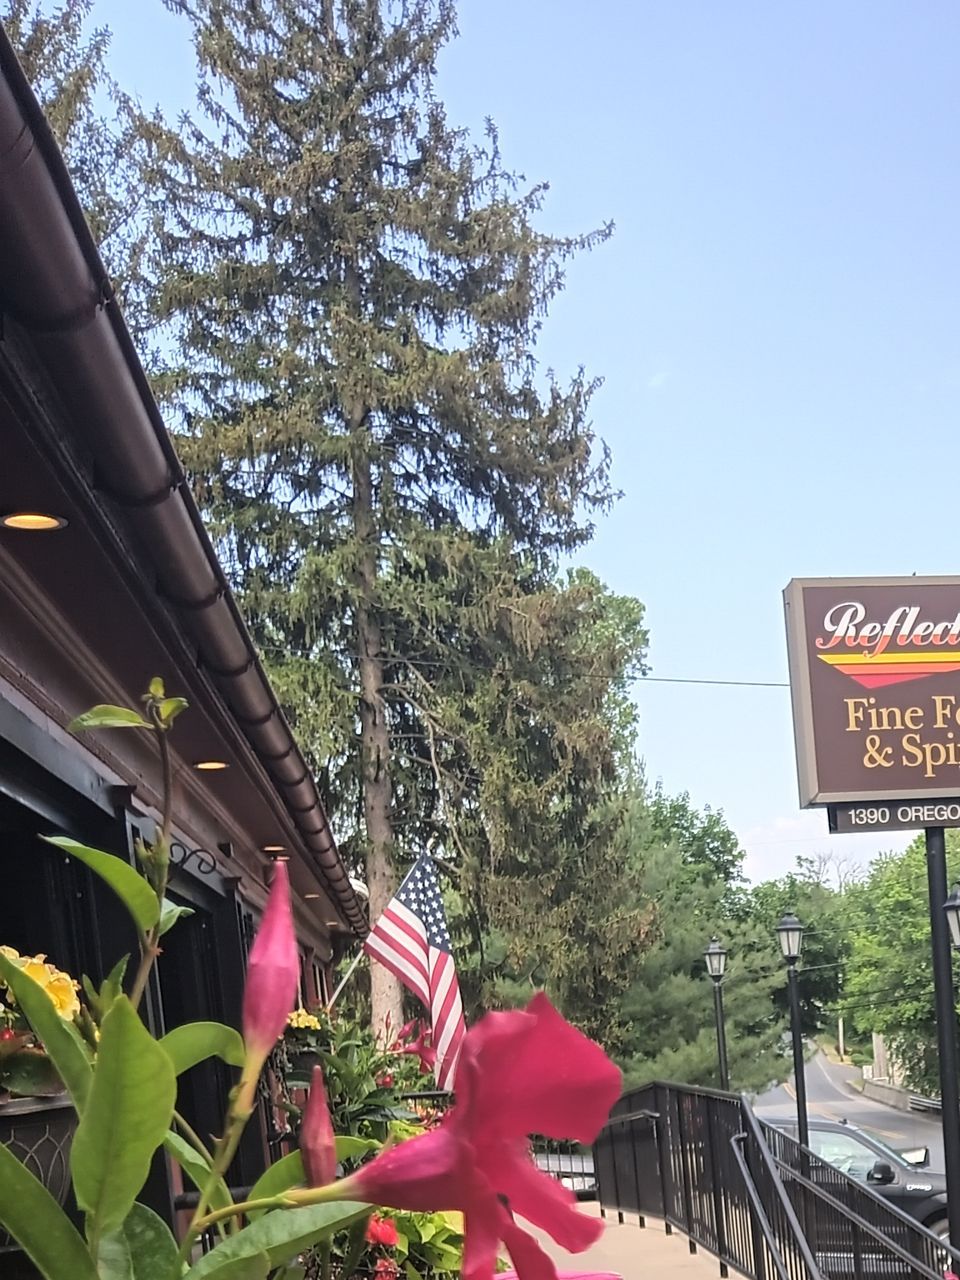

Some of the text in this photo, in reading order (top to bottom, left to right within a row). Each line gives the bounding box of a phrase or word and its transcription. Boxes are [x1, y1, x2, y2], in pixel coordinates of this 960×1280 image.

[844, 697, 924, 731] Fine
[863, 734, 894, 768] &
[848, 807, 890, 824] 1390
